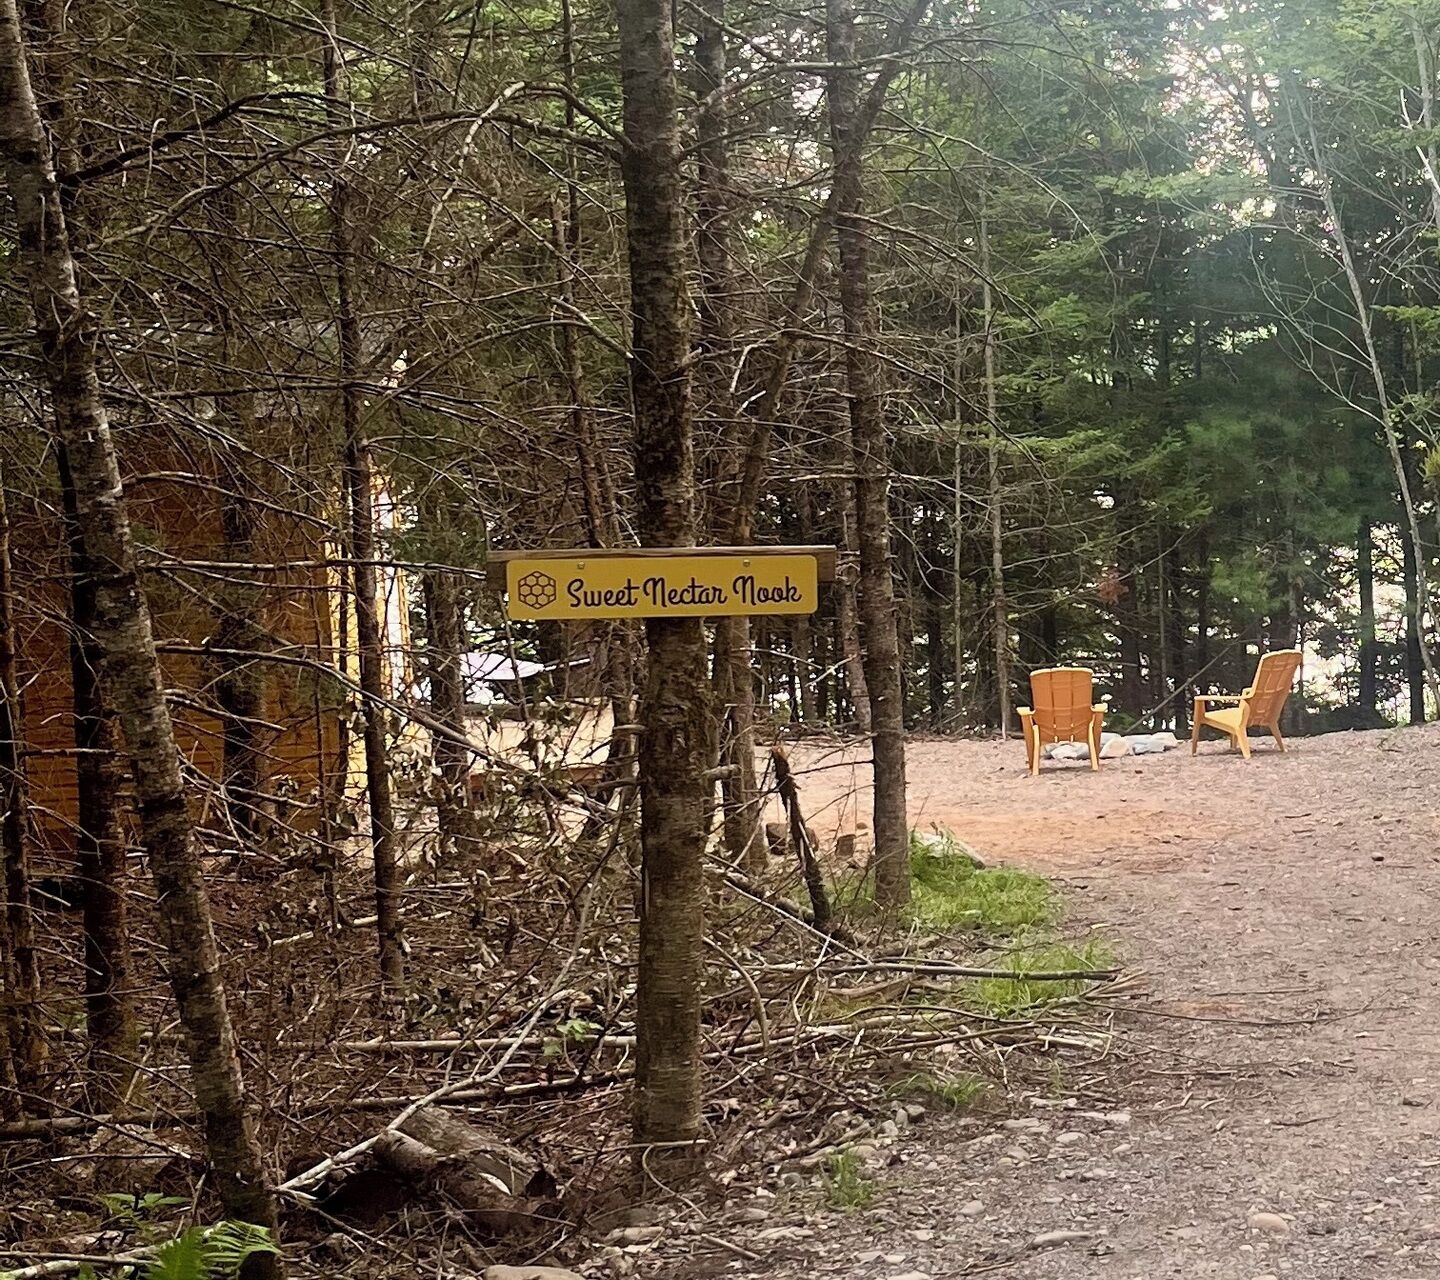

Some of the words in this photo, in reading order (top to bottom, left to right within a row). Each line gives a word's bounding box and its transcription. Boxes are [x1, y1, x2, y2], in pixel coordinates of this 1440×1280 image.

[567, 578, 640, 608] Sweet
[643, 577, 728, 608] Nectar
[733, 575, 802, 606] Nook
